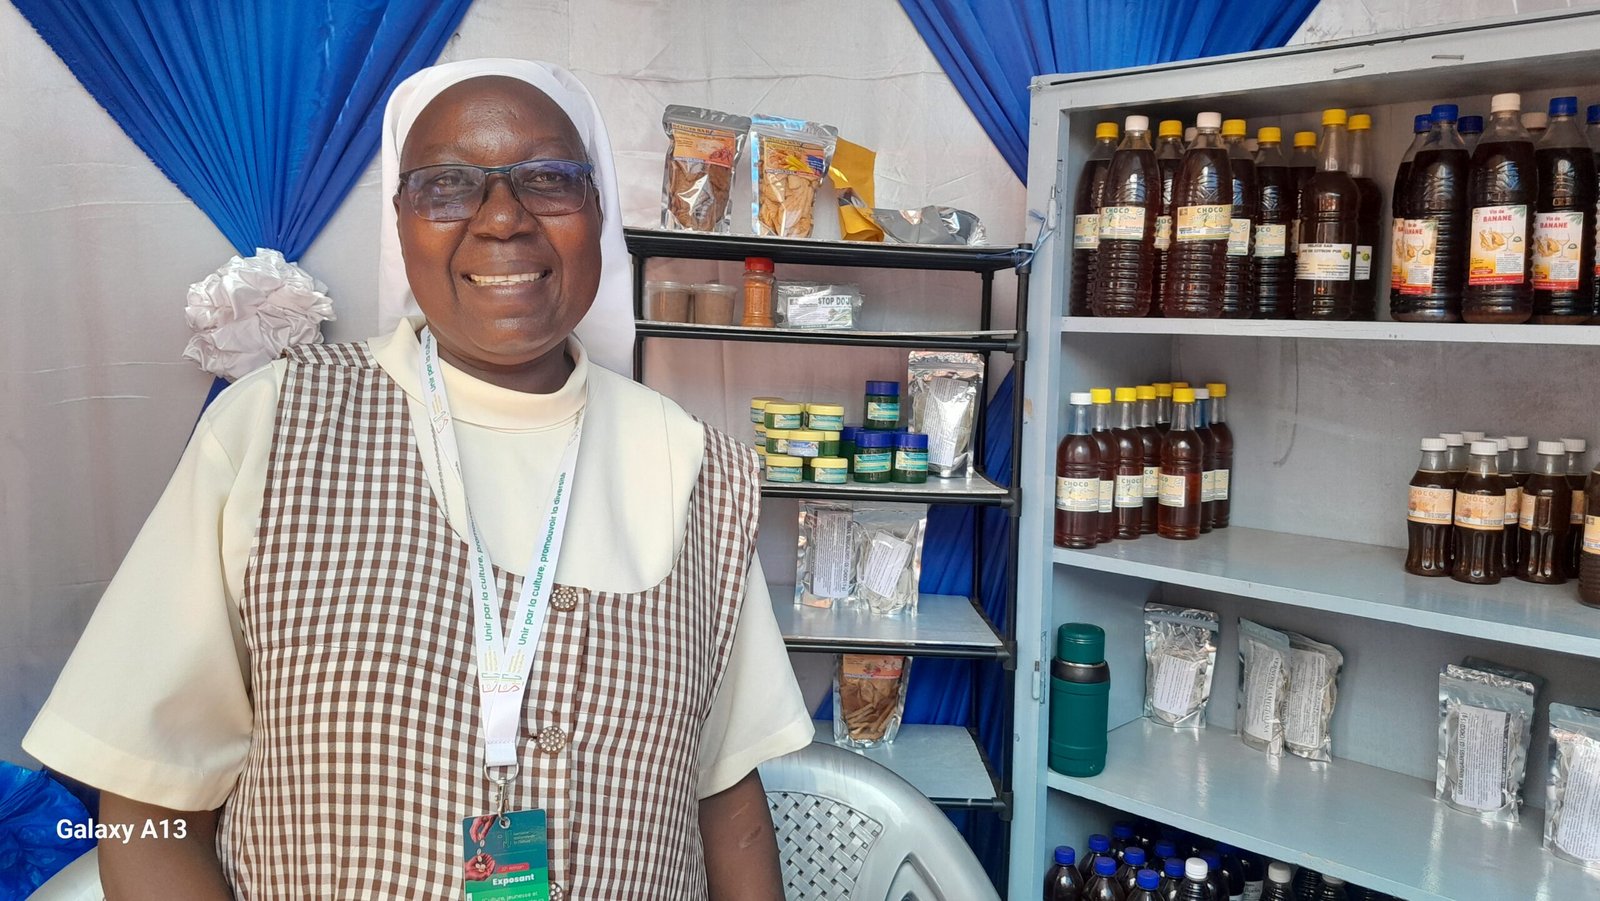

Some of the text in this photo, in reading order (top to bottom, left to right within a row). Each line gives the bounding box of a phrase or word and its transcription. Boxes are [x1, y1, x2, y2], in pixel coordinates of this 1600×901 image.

[1196, 206, 1224, 214] CHOCO
[818, 297, 835, 306] STOP
[1463, 495, 1491, 503] CHOCO
[551, 506, 559, 515] la
[540, 516, 557, 562] promouvoir
[478, 555, 487, 590] culture,
[532, 564, 546, 597] culture,
[482, 591, 488, 600] la
[528, 599, 537, 607] la
[483, 602, 493, 619] par
[525, 609, 534, 625] par
[484, 622, 492, 641] Unir
[518, 627, 529, 646] Unir
[492, 873, 535, 887] Exposant
